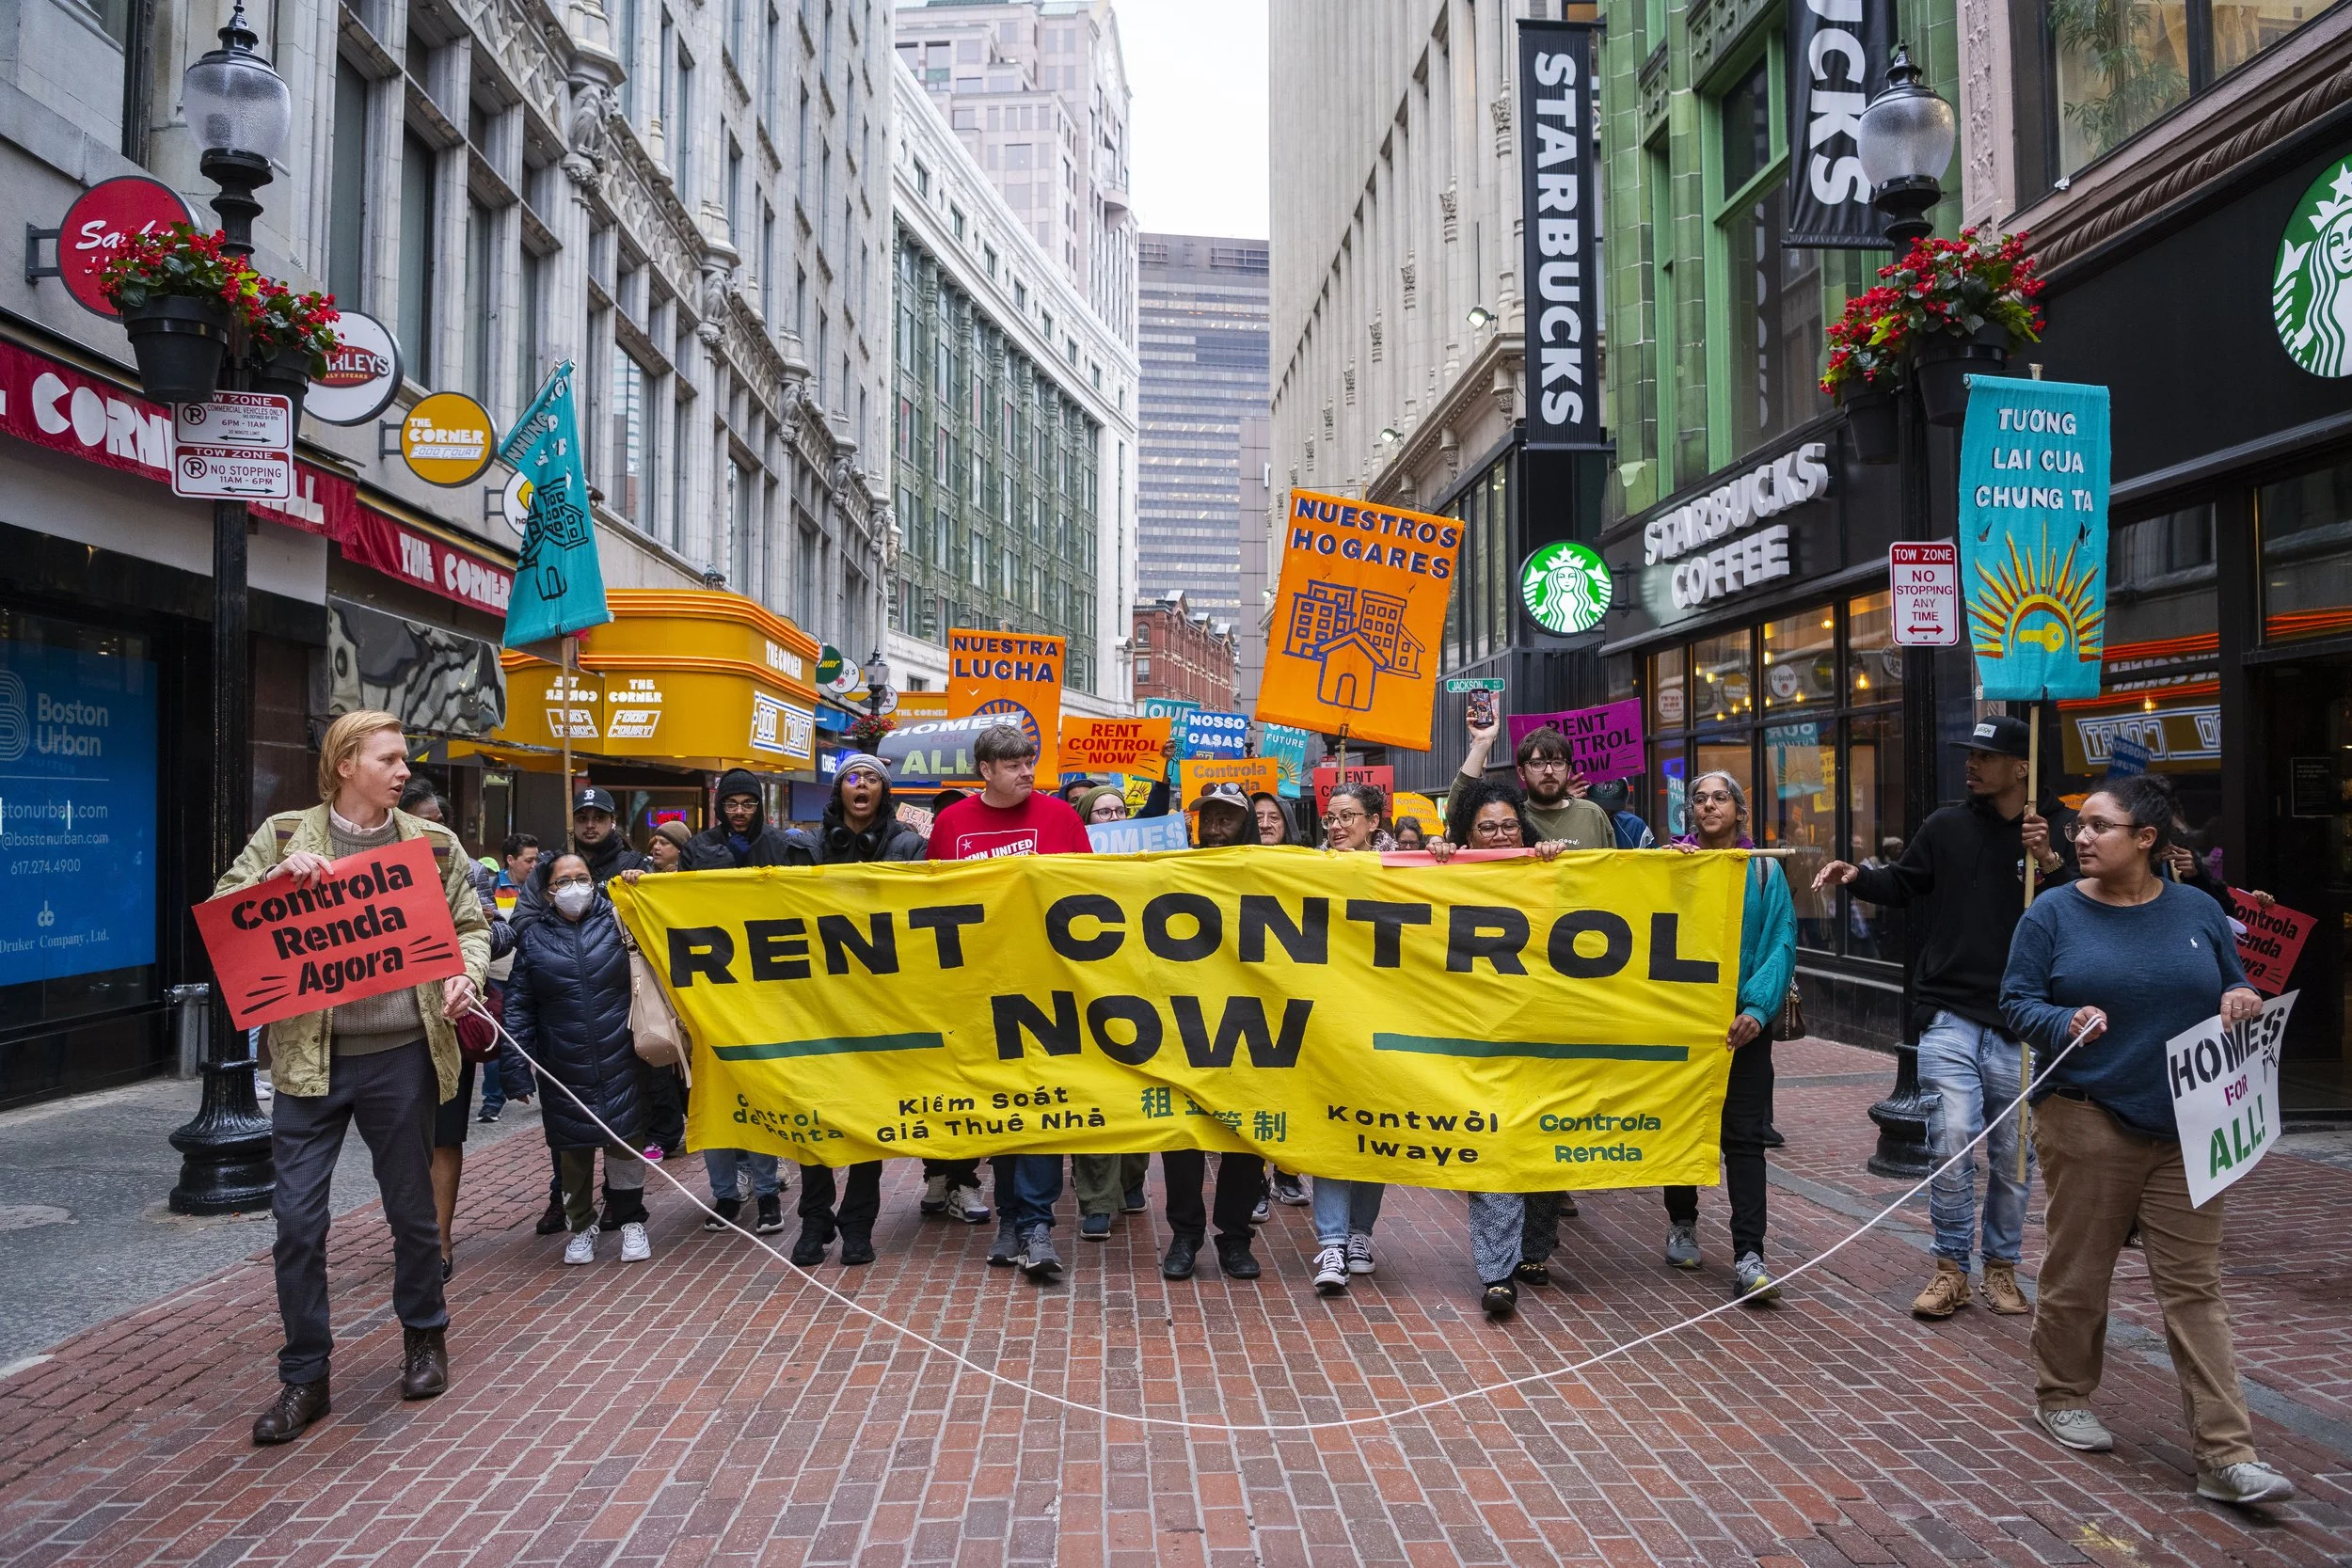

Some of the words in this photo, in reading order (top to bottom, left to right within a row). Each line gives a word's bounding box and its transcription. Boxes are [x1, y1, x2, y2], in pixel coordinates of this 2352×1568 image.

[1534, 51, 1583, 425] STARBUCKS
[207, 404, 242, 414] COMMERCIAL
[230, 395, 272, 406] ZONE
[409, 418, 432, 427] THE
[408, 429, 484, 444] CORNER
[231, 451, 273, 459] ZONE
[1993, 448, 2031, 469] LAI
[2041, 450, 2084, 473] CUA
[211, 465, 225, 474] NO
[230, 467, 281, 478] STOPPING
[1645, 443, 1828, 566] STARBUCKS
[1976, 485, 2063, 509] CHUNG
[2072, 489, 2093, 512] TA
[1295, 498, 1457, 548] NUESTROS
[1291, 528, 1451, 578] HOGARES
[1895, 549, 1916, 561] TOW
[1923, 549, 1952, 561] ZONE
[400, 532, 434, 583] THE
[444, 553, 511, 610] CORNER
[1672, 525, 1789, 610] COFFEE
[1913, 570, 1935, 582] NO
[1897, 585, 1953, 594] STOPPING
[1913, 598, 1935, 608] ANY
[1912, 611, 1939, 621] TIME
[953, 637, 1058, 657] NUESTRA
[954, 658, 1054, 682] LUCHA
[629, 679, 655, 689] THE
[1453, 680, 1483, 691] JACKSON
[609, 691, 662, 703] CORNER
[38, 692, 109, 727] Boston
[883, 714, 1018, 738] HOMES
[1091, 723, 1142, 737] RENT
[1189, 715, 1246, 730] NOSSO
[1546, 712, 1609, 736] RENT
[38, 725, 101, 756] Urban
[1069, 737, 1159, 752] CONTROL
[1188, 733, 1244, 749] CASAS
[1265, 734, 1305, 749] FUTURE
[1089, 752, 1136, 765] NOW
[1572, 753, 1611, 775] OW
[1194, 763, 1267, 778] Controla
[1090, 821, 1184, 853] OMES
[992, 839, 1033, 857] UNITED
[11, 859, 80, 875] 617.274.4900
[231, 862, 414, 930] Controla
[2235, 902, 2298, 940] ontrola
[90, 929, 109, 942] Ltd.
[272, 904, 407, 960] Renda
[666, 904, 984, 988] RENT
[1045, 893, 1719, 983] CONTROL
[2237, 932, 2282, 958] enda
[298, 946, 405, 996] Agora
[992, 991, 1311, 1069] NOW
[2169, 1006, 2285, 1099] HOMES
[2224, 1073, 2248, 1106] FOR
[877, 1120, 929, 1142] Giá
[945, 1114, 1024, 1136] Thuê
[1539, 1113, 1661, 1132] Controla
[2210, 1094, 2265, 1180] ALL!
[1554, 1143, 1643, 1164] Renda
